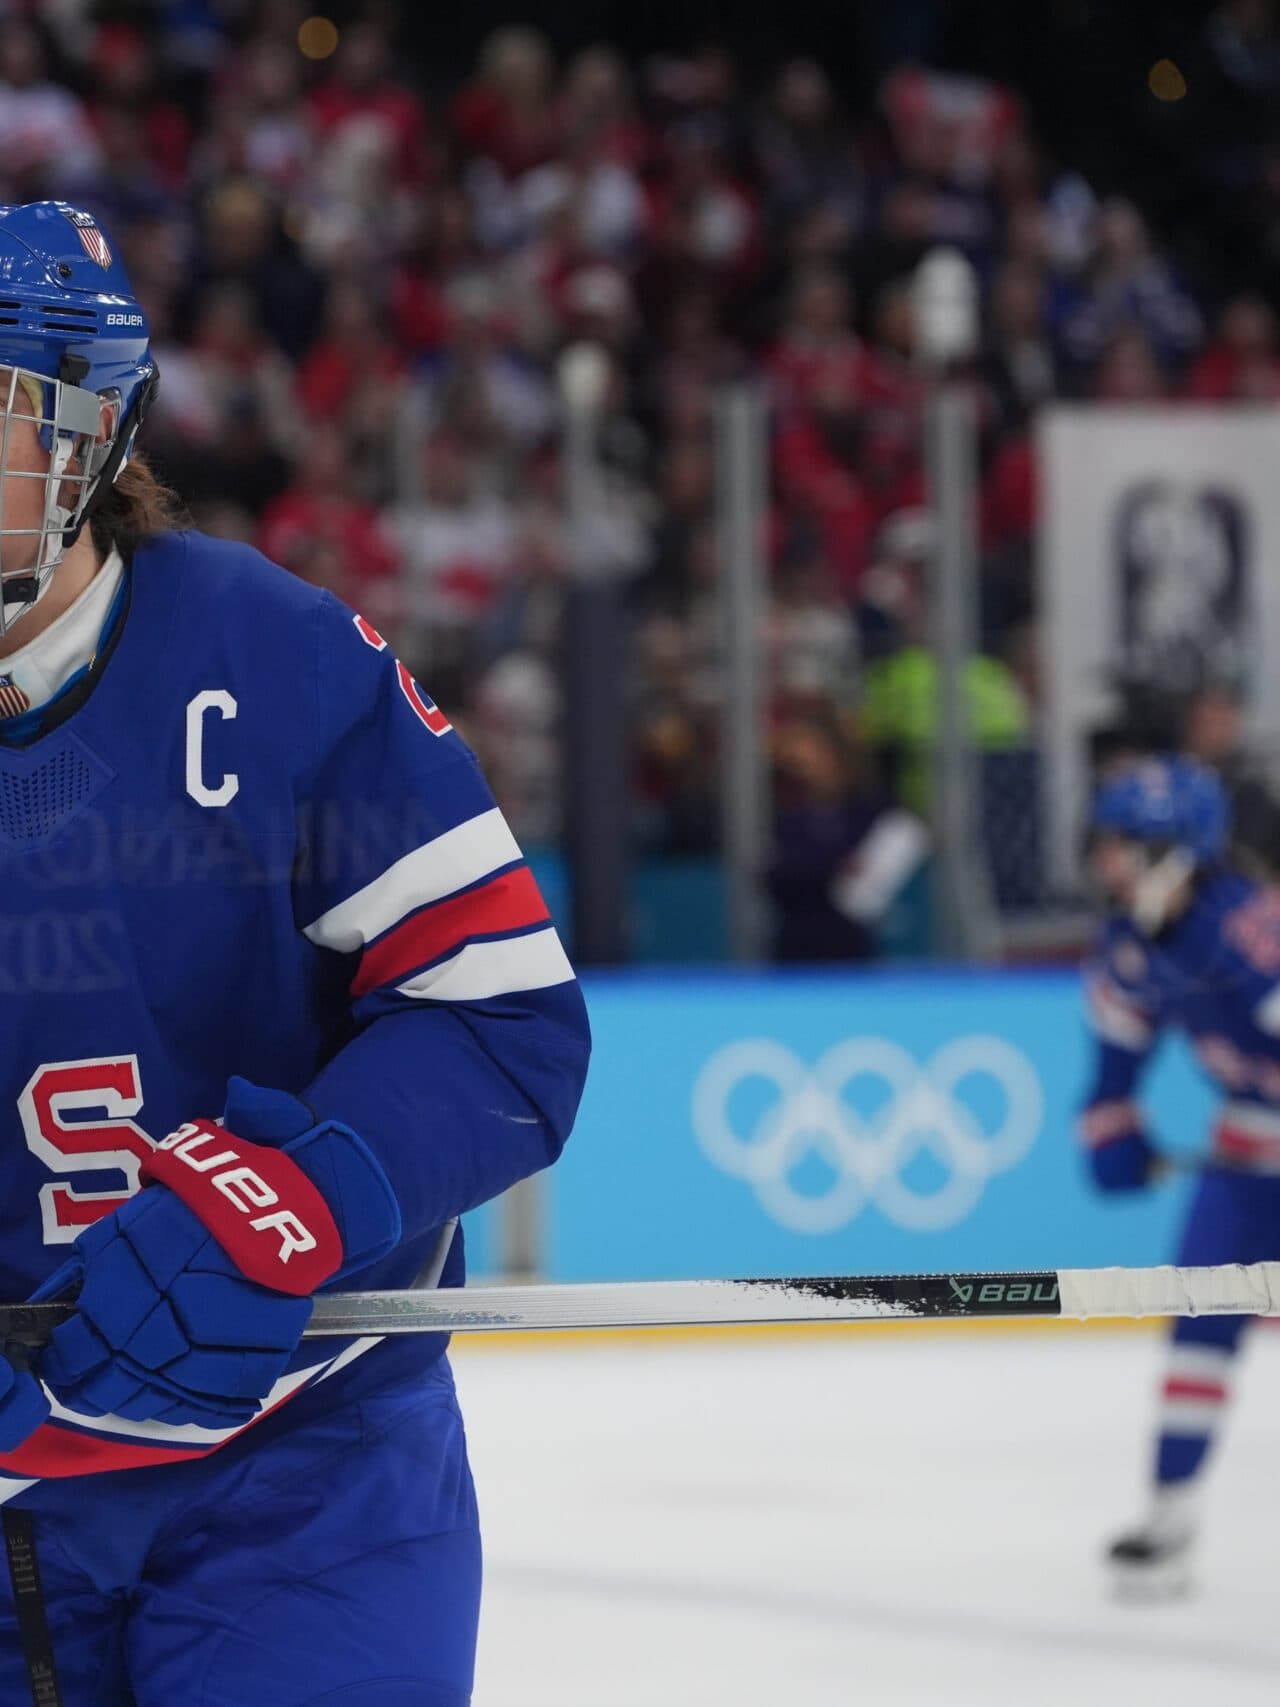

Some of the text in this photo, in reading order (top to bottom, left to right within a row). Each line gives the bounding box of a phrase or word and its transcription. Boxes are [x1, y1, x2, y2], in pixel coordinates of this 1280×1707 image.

[186, 689, 239, 807] C
[158, 1122, 317, 1264] AUER
[978, 1282, 1059, 1302] BAU
